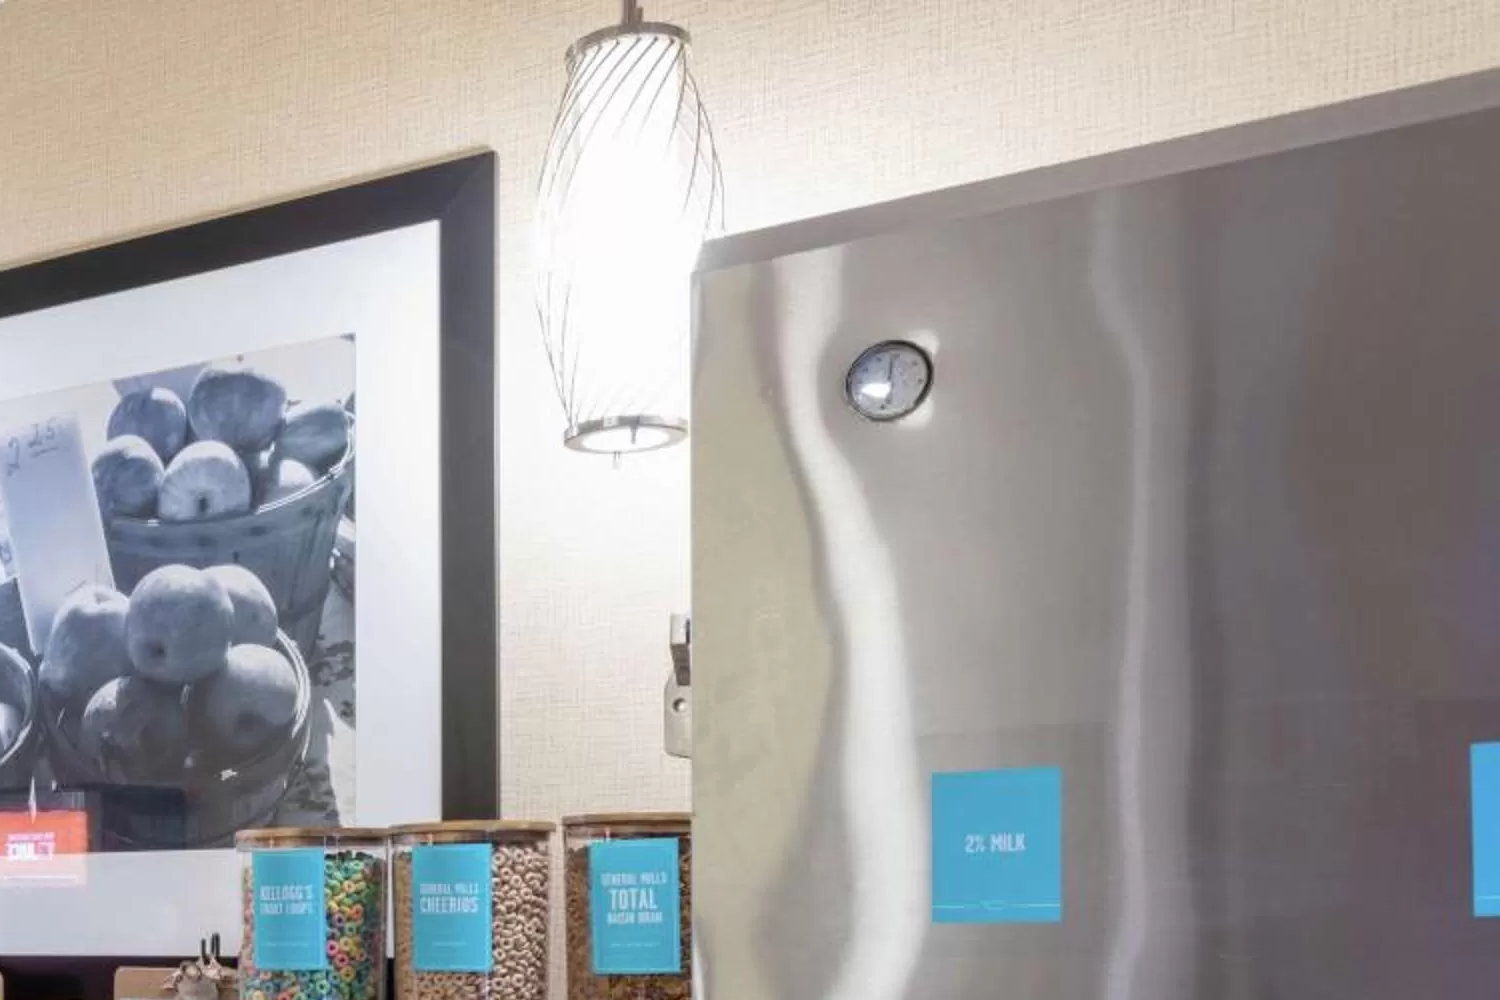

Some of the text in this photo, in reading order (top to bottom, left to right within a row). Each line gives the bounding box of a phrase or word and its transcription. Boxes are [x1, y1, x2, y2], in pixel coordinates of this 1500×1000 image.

[964, 832, 1027, 853] 2% MILK
[420, 895, 479, 913] CHEERIOS
[608, 887, 658, 910] TOTAL
